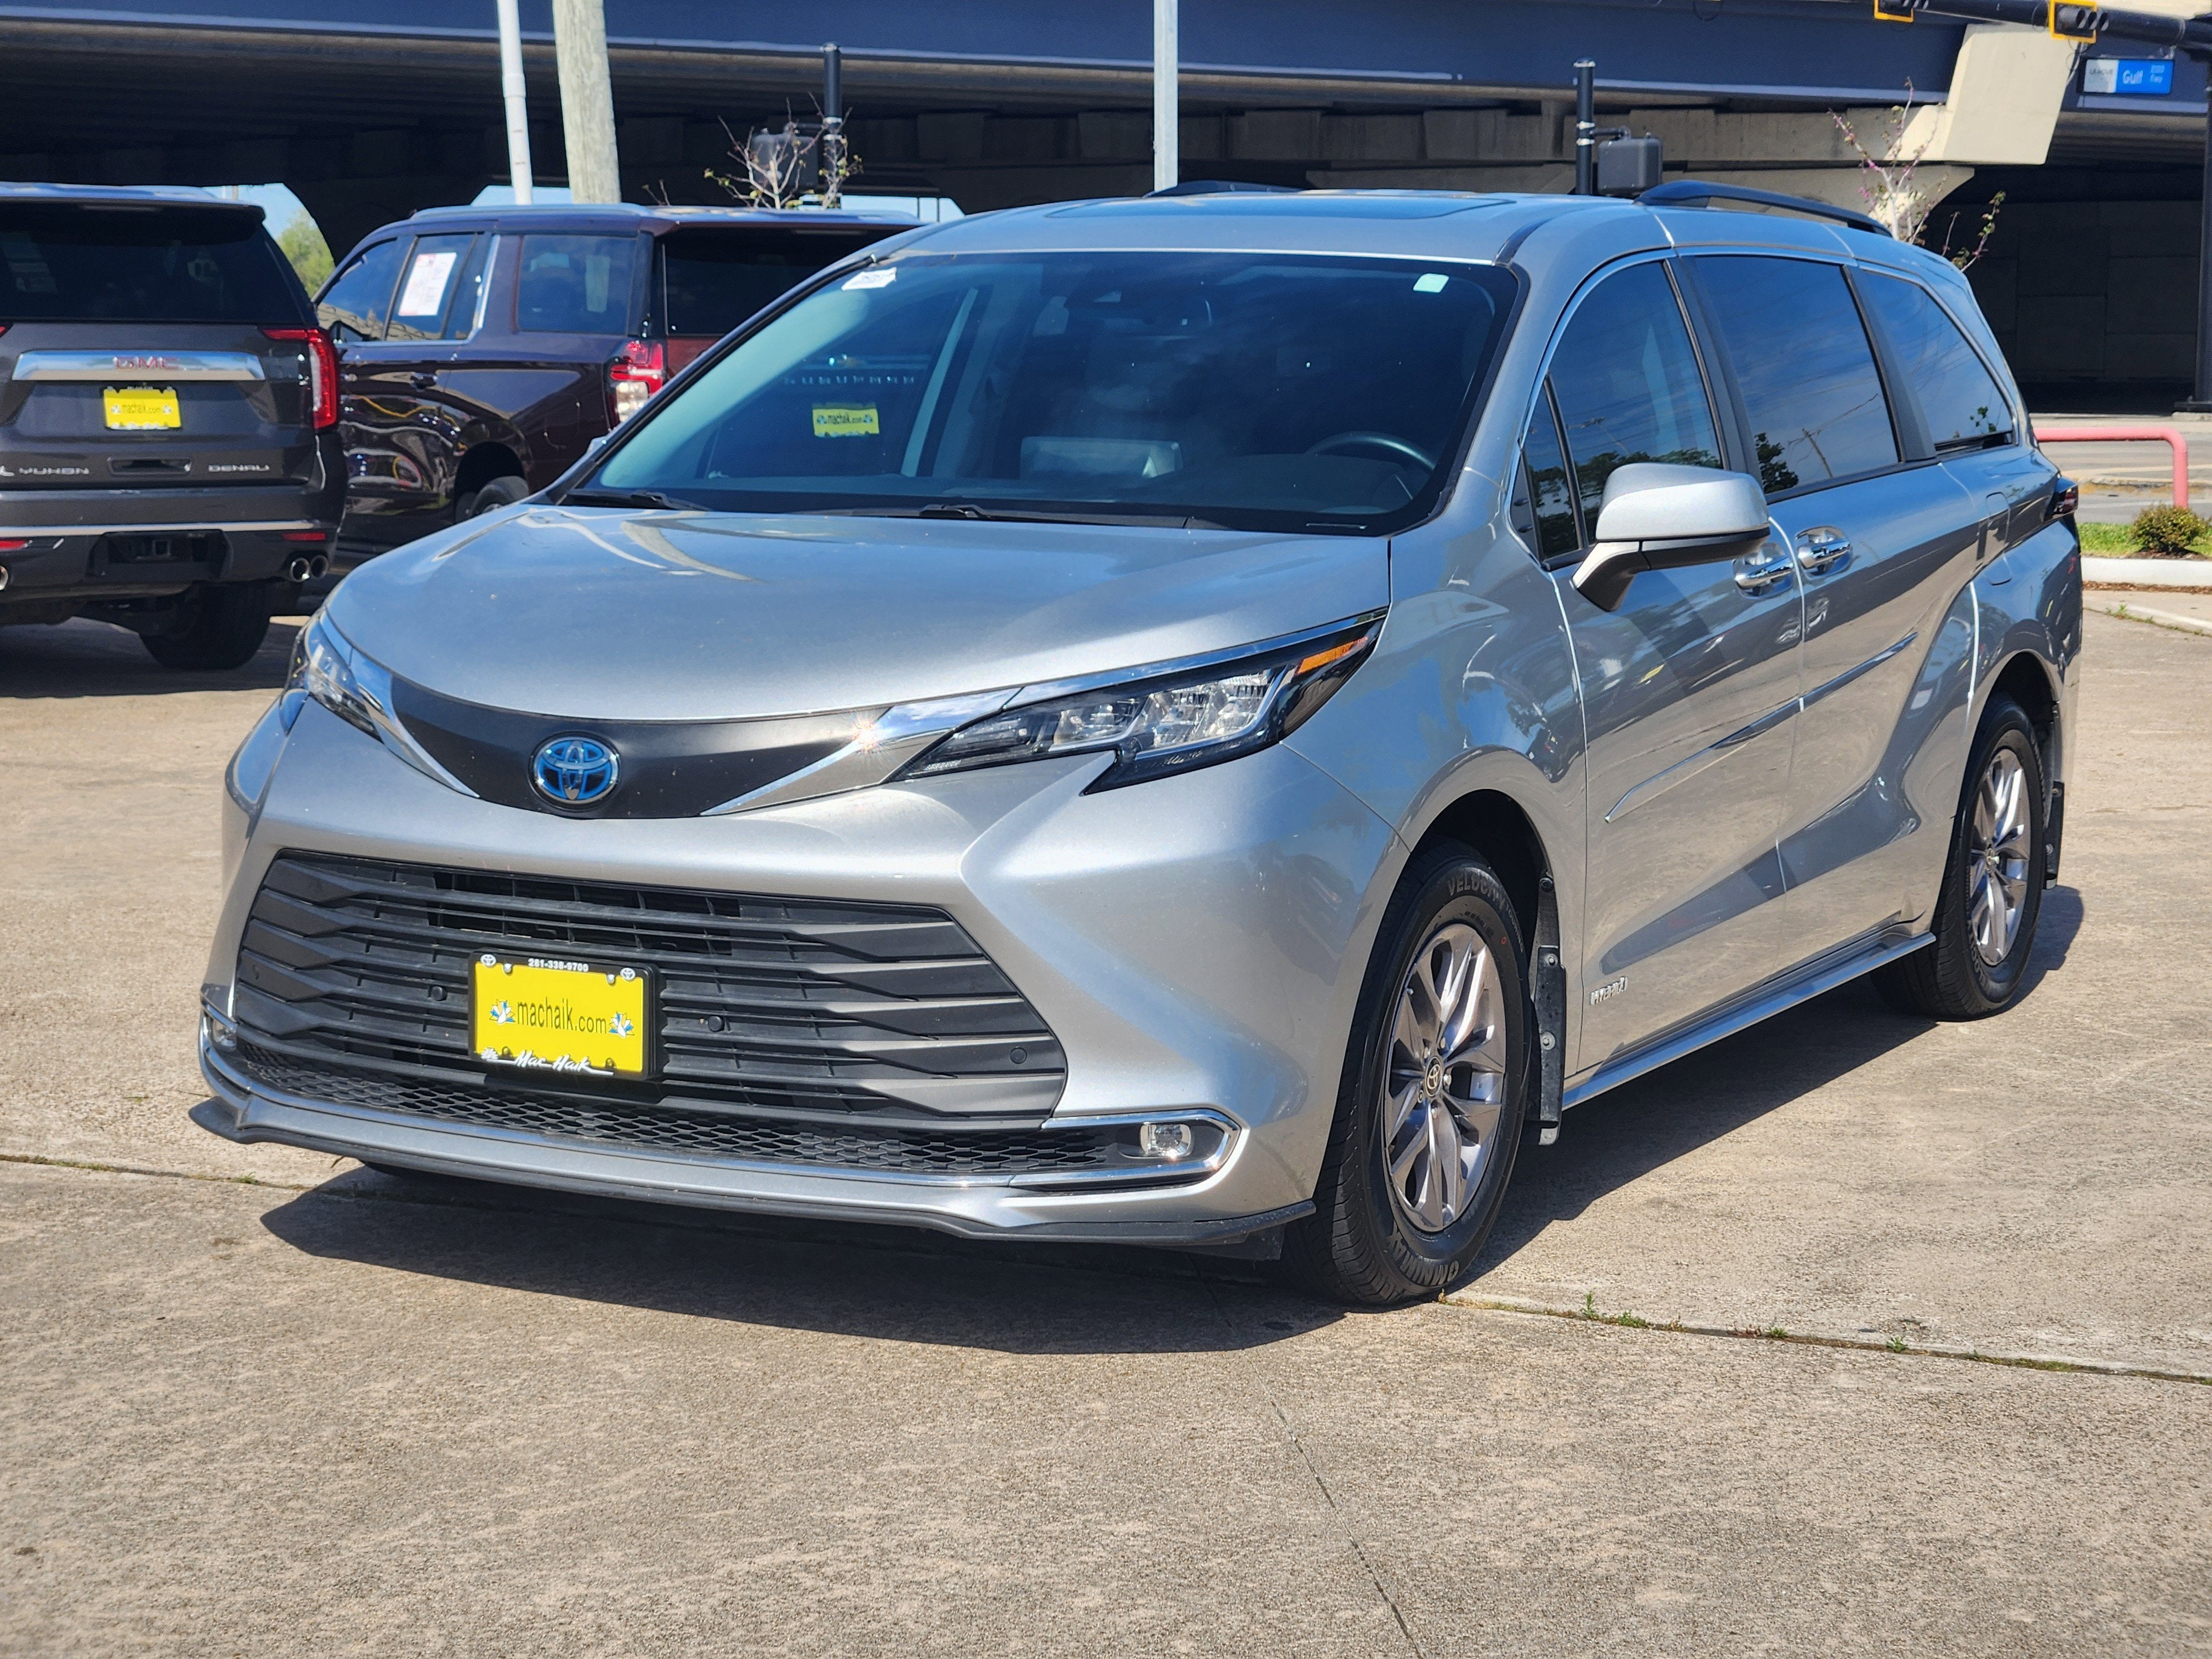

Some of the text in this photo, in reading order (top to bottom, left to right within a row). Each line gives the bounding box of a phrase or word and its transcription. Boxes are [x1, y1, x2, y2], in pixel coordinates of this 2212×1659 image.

[517, 997, 607, 1034] machaik.com
[515, 1050, 596, 1073] Mac Haik
